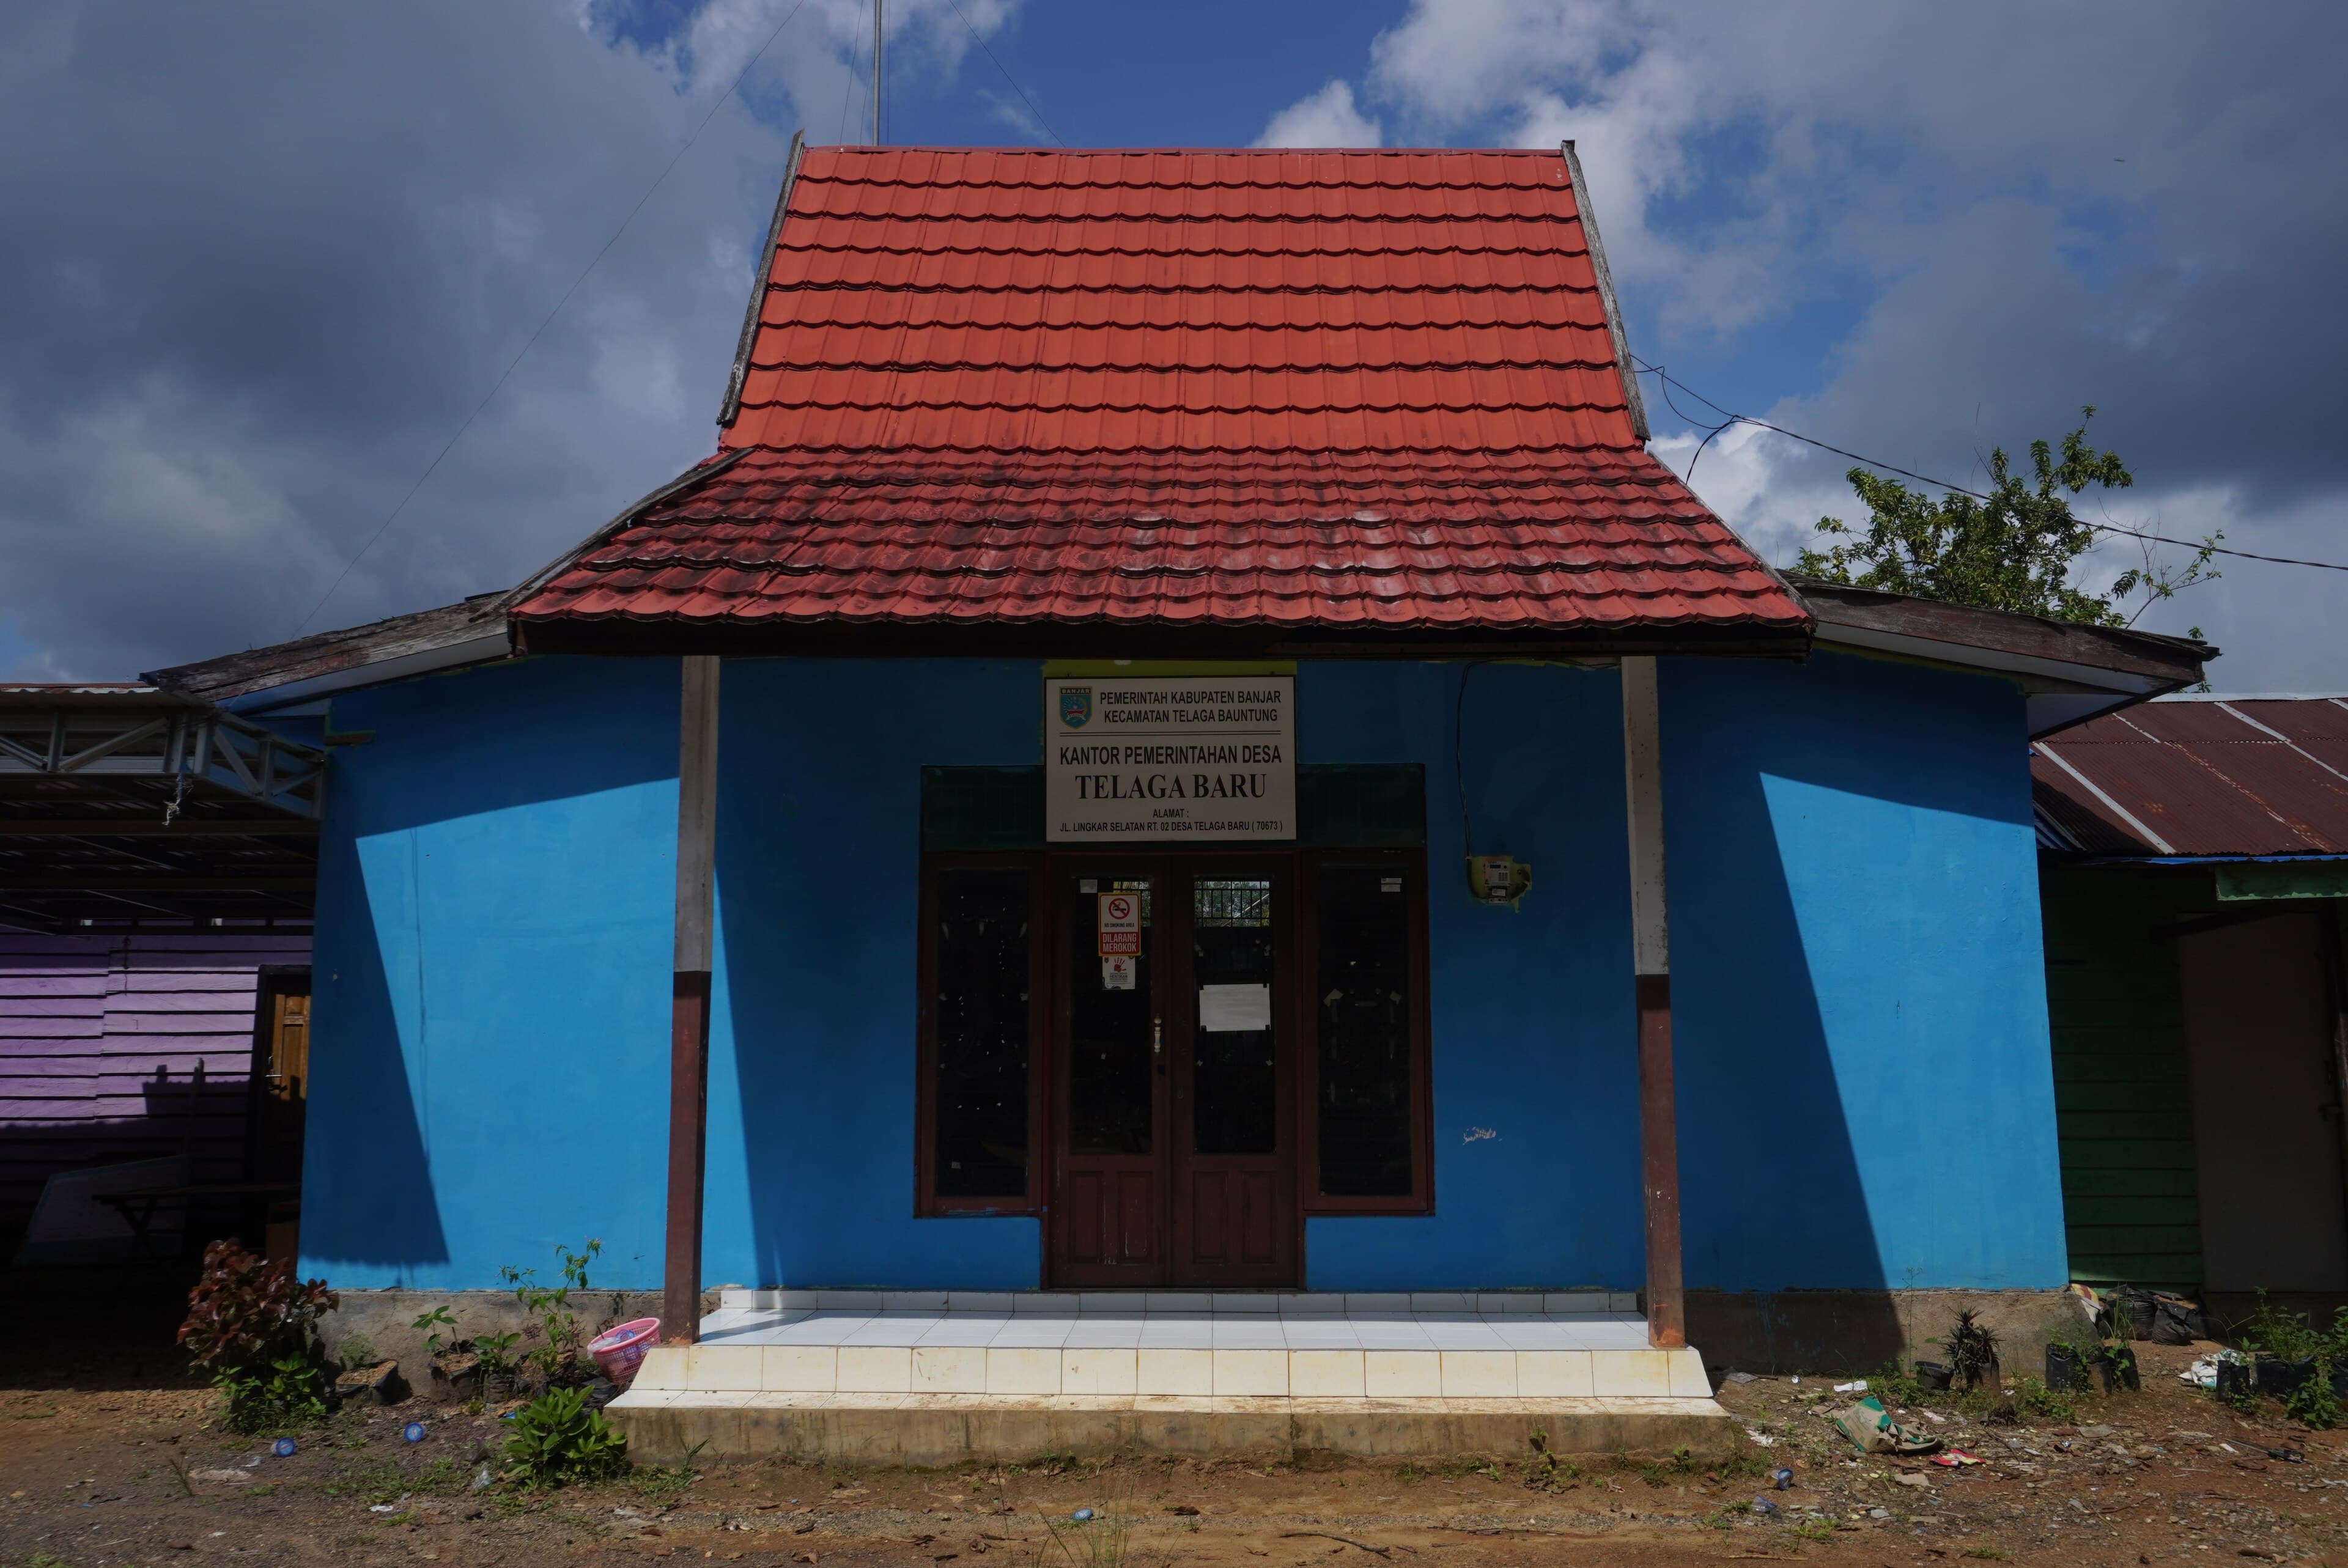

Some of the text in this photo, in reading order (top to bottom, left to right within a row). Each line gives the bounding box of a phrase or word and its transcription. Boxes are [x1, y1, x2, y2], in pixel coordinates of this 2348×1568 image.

[1100, 690, 1281, 705] PEMERINTAH KABUPATEN BANJAR
[1104, 709, 1277, 723] KECAMATAN TELAGA BAUNTUNG
[1060, 745, 1282, 765] KANTOR PEMERINTAHAN DESA
[1075, 773, 1267, 799] TELAGA BARU
[1153, 809, 1184, 818] ALAMAT
[1060, 822, 1071, 832] JL.
[1073, 822, 1108, 832] LINGKAR
[1110, 822, 1145, 832] SELATAN
[1147, 822, 1159, 831] RT.
[1161, 822, 1169, 831] 02
[1171, 822, 1193, 831] DESA
[1194, 821, 1226, 831] TELAGA
[1227, 821, 1250, 831] BARU
[1102, 933, 1137, 943] DILARANG
[1102, 943, 1137, 952] MEROKOK
